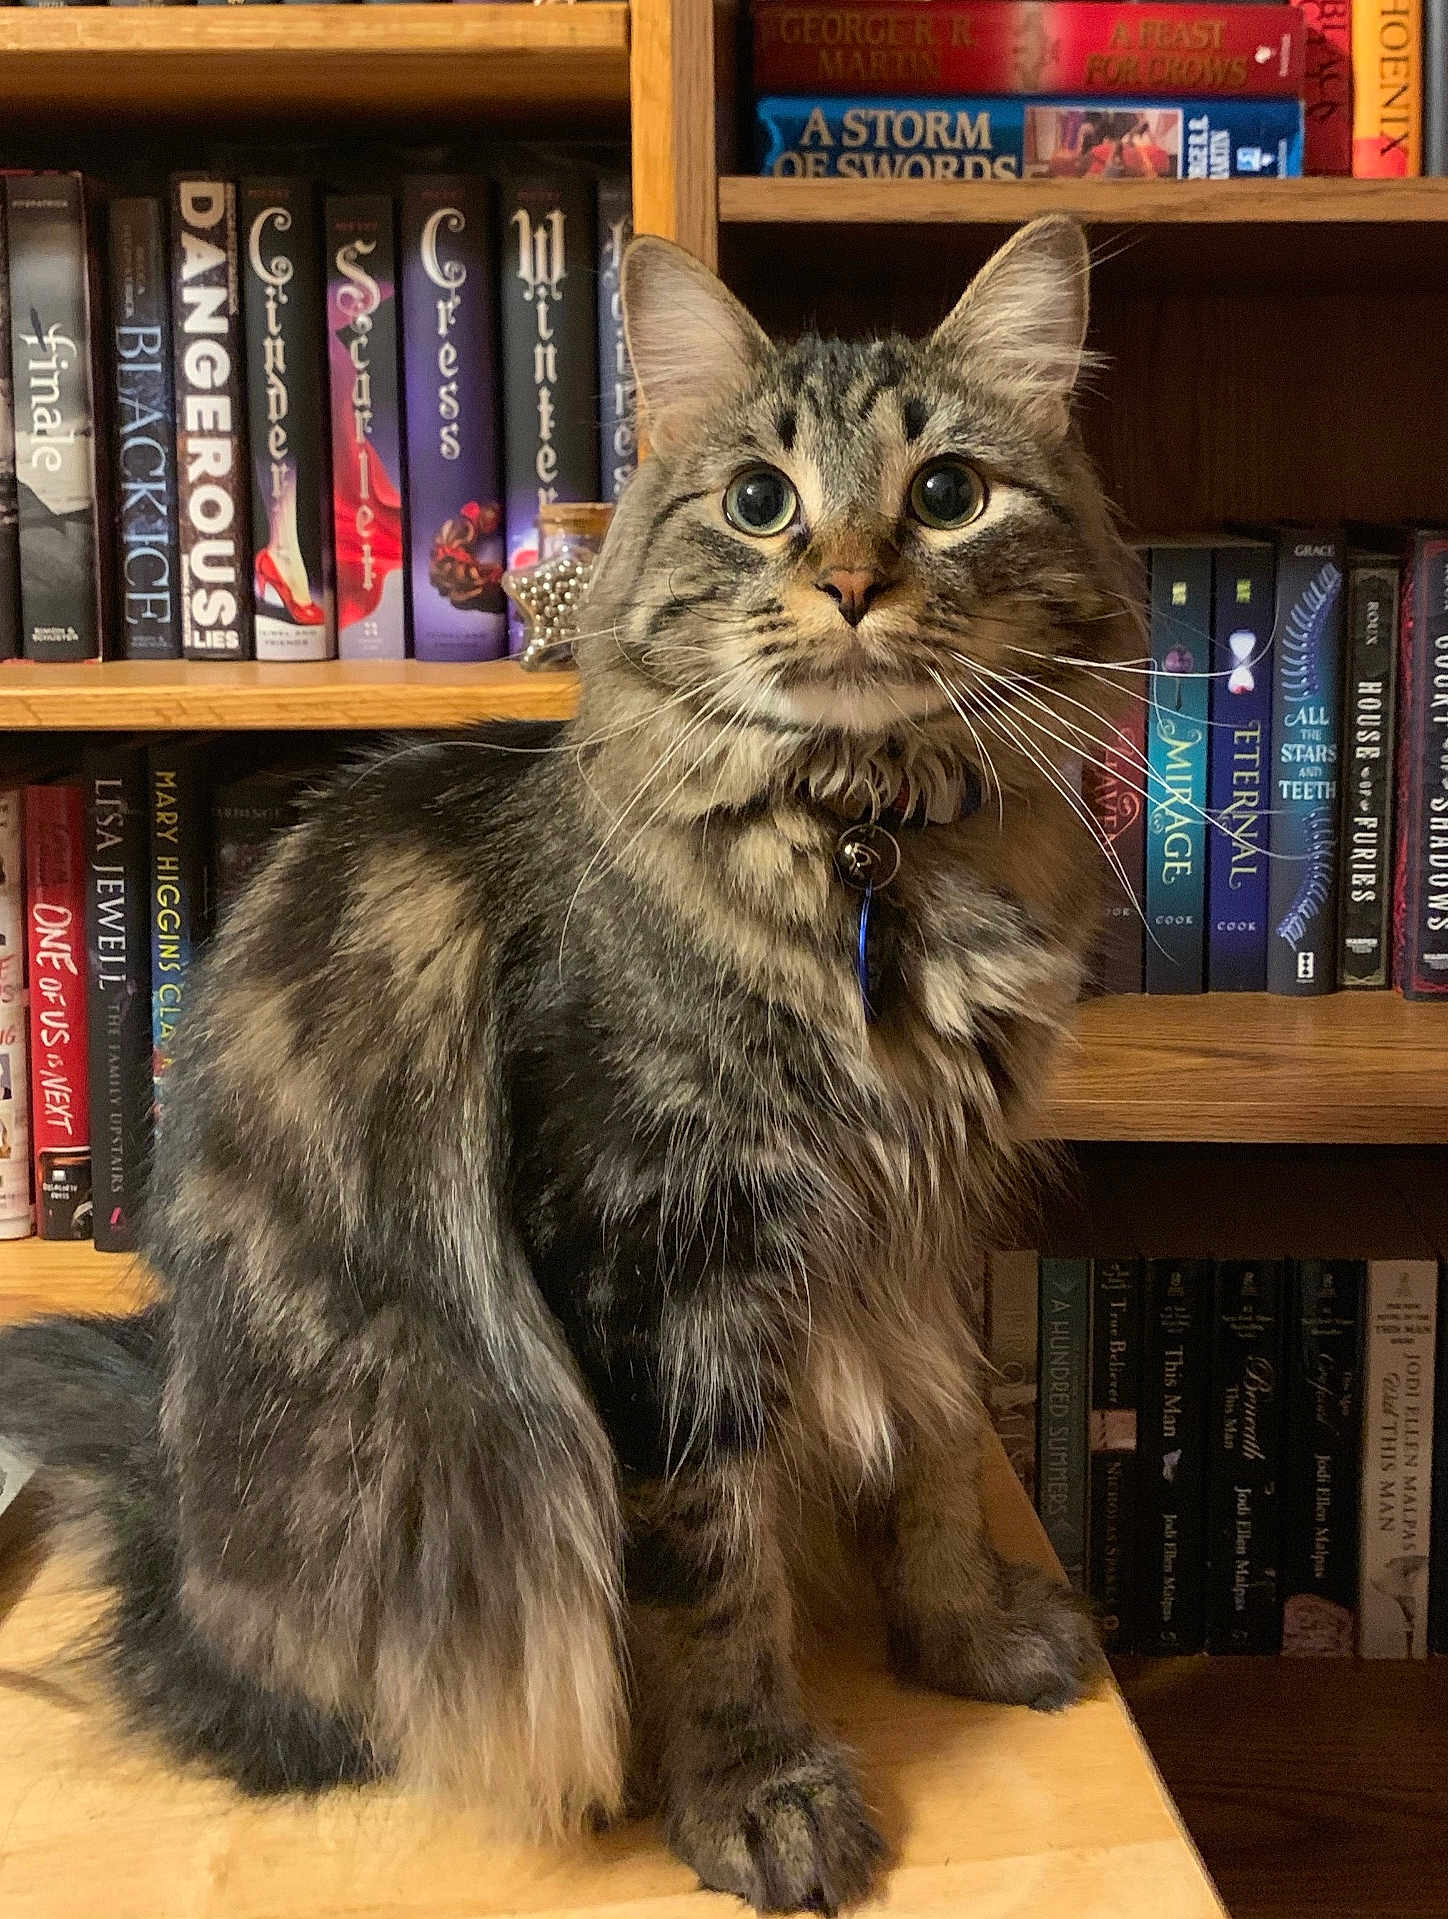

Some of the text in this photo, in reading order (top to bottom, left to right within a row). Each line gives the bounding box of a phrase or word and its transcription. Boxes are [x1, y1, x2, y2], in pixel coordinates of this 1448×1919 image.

[779, 13, 904, 45] GEORGE
[1108, 19, 1224, 49] A FEAST
[818, 48, 940, 81] MARTIN
[1086, 52, 1139, 85] FOR
[1148, 54, 1249, 86] CROWS
[798, 106, 993, 150] A STORM
[773, 152, 1018, 179] OF SWORDS
[248, 206, 294, 500] Cinder
[420, 206, 467, 460] Cress
[510, 208, 568, 506] Winter
[19, 322, 77, 471] finale
[179, 180, 238, 627] DANGEROUS
[335, 239, 381, 591] Scarlet
[193, 629, 240, 649] LIES
[1283, 705, 1331, 728] ALL
[1300, 728, 1322, 740] THE
[1355, 680, 1383, 760] HOUSE
[1280, 743, 1338, 763] STARS
[1299, 766, 1322, 778] AND
[154, 769, 179, 844] MARY
[1152, 719, 1201, 886] MIRAGE
[1220, 720, 1261, 890] ETERNAL
[1278, 779, 1338, 800] TEETH
[92, 778, 127, 991] LISA JEWELL
[1349, 816, 1379, 903] FURIES
[1426, 797, 1448, 932] SHADOWS
[32, 902, 78, 976] ONE
[156, 855, 182, 973] HIGGINS
[1154, 914, 1194, 926] COOK
[1216, 920, 1257, 932] COOK
[39, 976, 67, 1006] OF
[40, 1009, 70, 1048] US
[41, 1070, 75, 1135] NEXT
[108, 1004, 124, 1194] THE FAMILY UPSTAIRS
[1048, 1298, 1070, 1313] A
[1047, 1320, 1072, 1418] HUNDRED
[1163, 1343, 1184, 1387] This
[1161, 1392, 1183, 1438] Man
[1223, 1384, 1240, 1449] This Man
[1239, 1353, 1273, 1460] Beneath
[1313, 1454, 1331, 1480] Jodi
[1381, 1421, 1398, 1472] THIS
[1402, 1351, 1420, 1553] JODI ELLEN MALPAS
[1233, 1485, 1253, 1516] Jodi
[1379, 1480, 1395, 1531] MAN
[1234, 1520, 1252, 1555] Ellen
[1231, 1559, 1251, 1611] Malpas
